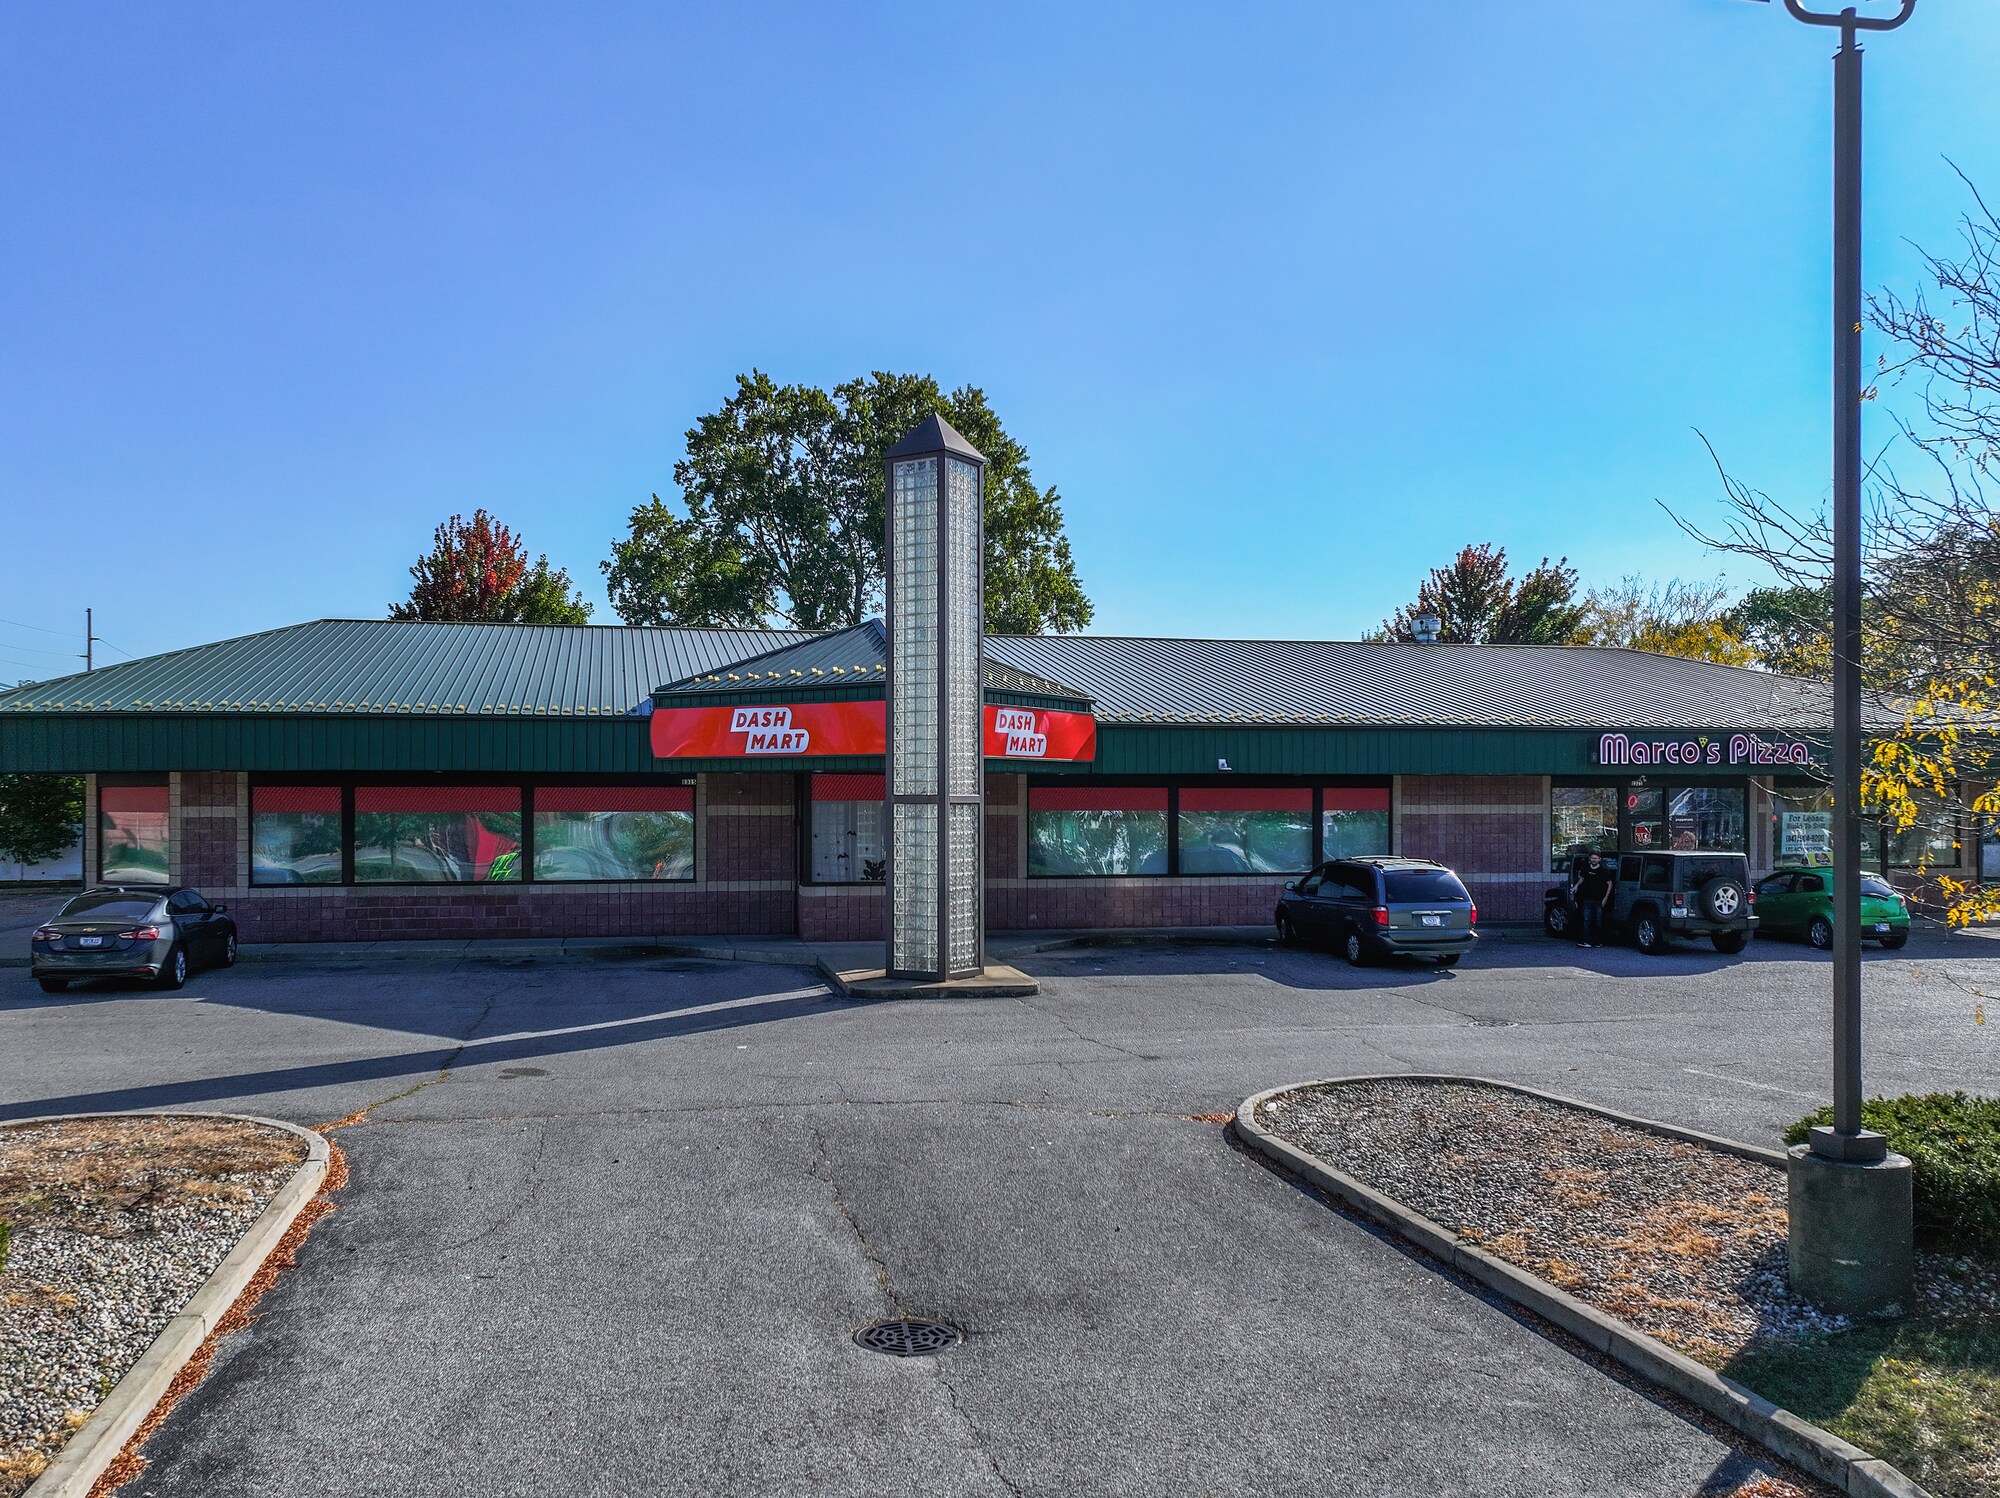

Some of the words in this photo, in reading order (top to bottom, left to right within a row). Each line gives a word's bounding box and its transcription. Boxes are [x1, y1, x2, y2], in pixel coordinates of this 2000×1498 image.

[736, 711, 787, 728] DASH
[999, 713, 1033, 731] DASH
[750, 733, 805, 750] MART
[1009, 736, 1044, 753] MART
[1600, 733, 1721, 765] Marco's
